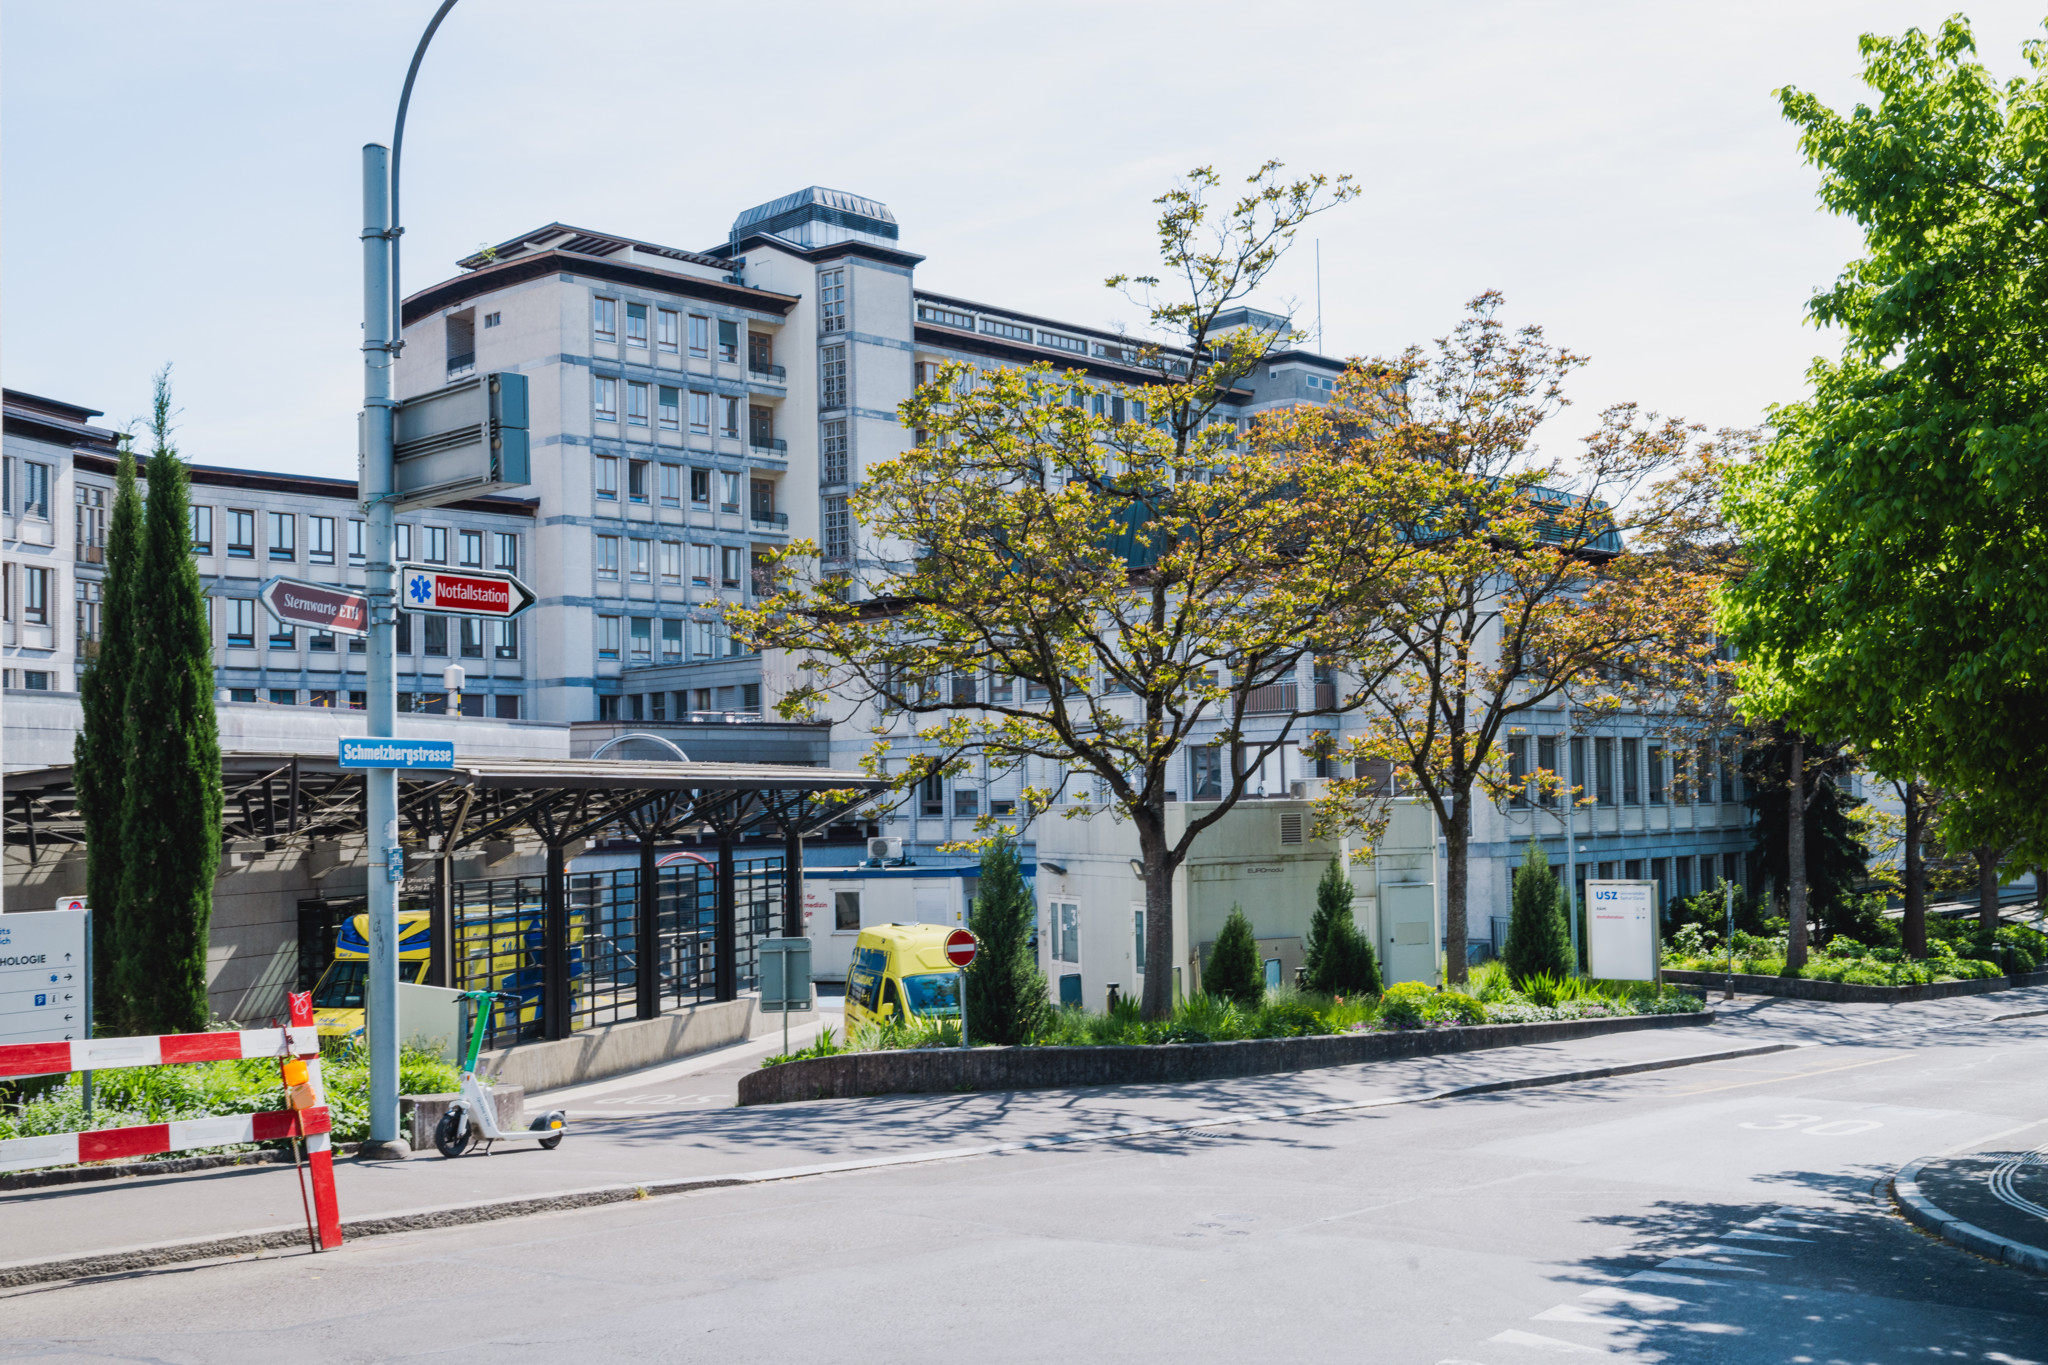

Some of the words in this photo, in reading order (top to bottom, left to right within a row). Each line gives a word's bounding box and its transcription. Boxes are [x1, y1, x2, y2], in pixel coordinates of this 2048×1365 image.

[437, 582, 508, 604] Notfallstation
[284, 593, 337, 616] Sternwarte
[339, 604, 359, 620] ETH
[344, 743, 452, 766] Schmelzbergstrasse
[1596, 891, 1618, 900] USZ
[1071, 909, 1077, 926] 3
[0, 954, 46, 966] HOLOGIE
[594, 1094, 731, 1105] STOP
[1738, 1113, 1884, 1136] 30
